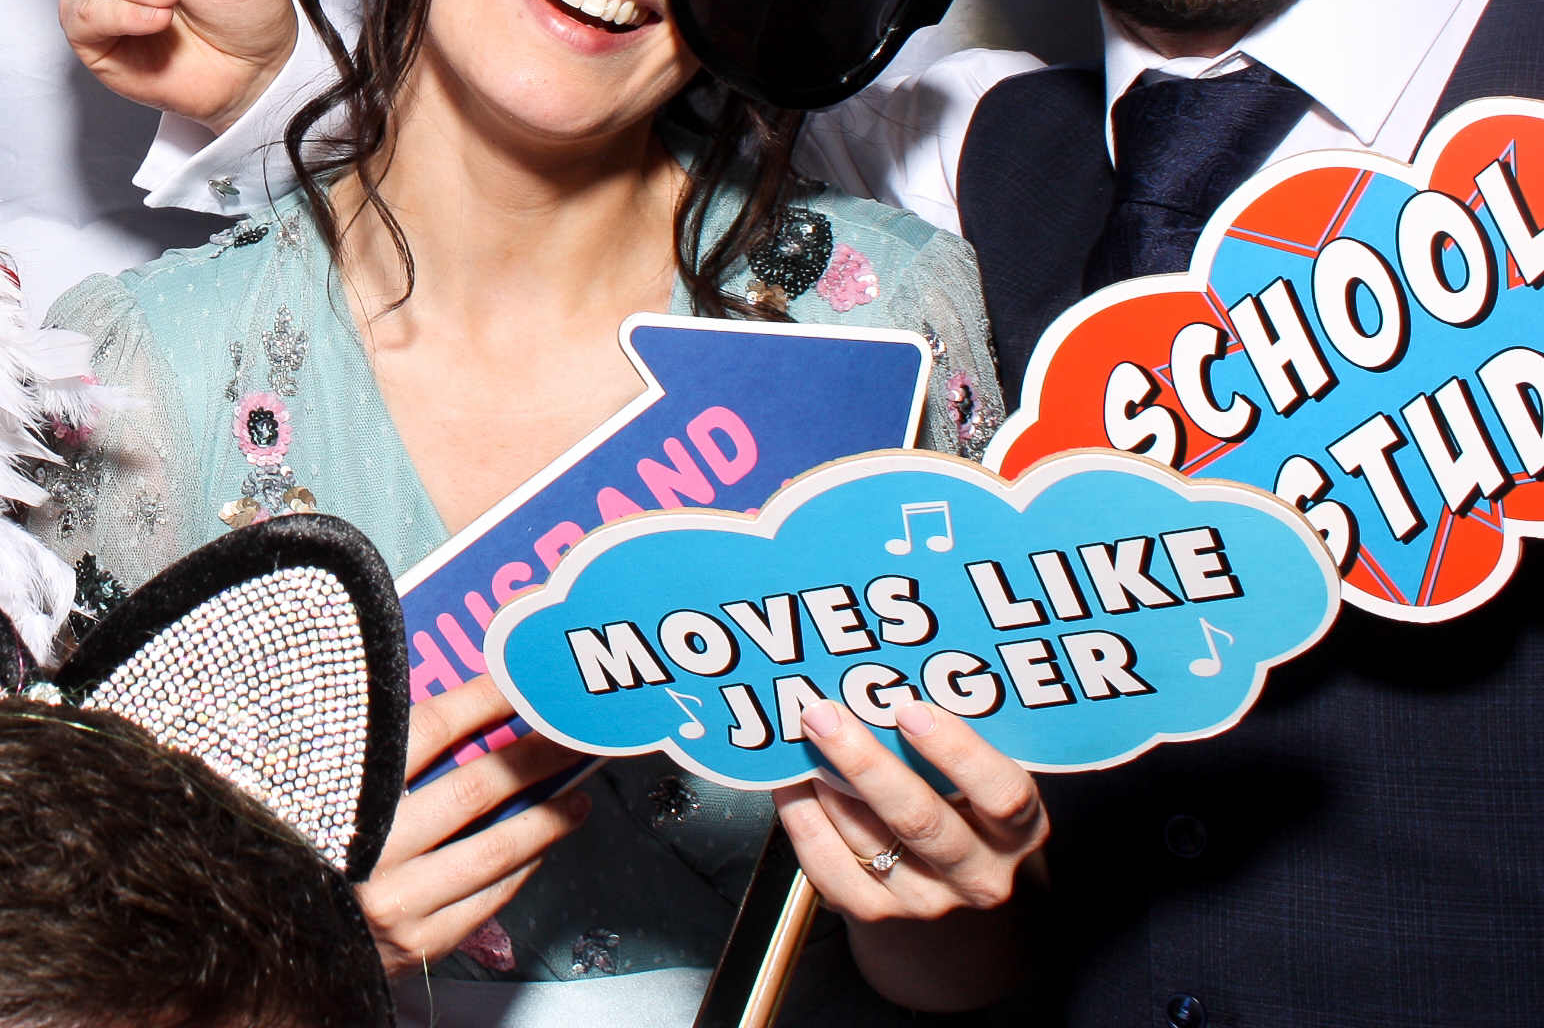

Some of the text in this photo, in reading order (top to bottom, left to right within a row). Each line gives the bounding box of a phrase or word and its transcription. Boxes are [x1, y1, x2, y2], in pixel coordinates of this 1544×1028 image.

[1103, 158, 1544, 472] SCHOOL
[565, 525, 1244, 695] MOVES LIKE
[718, 630, 1156, 751] JAGGER
